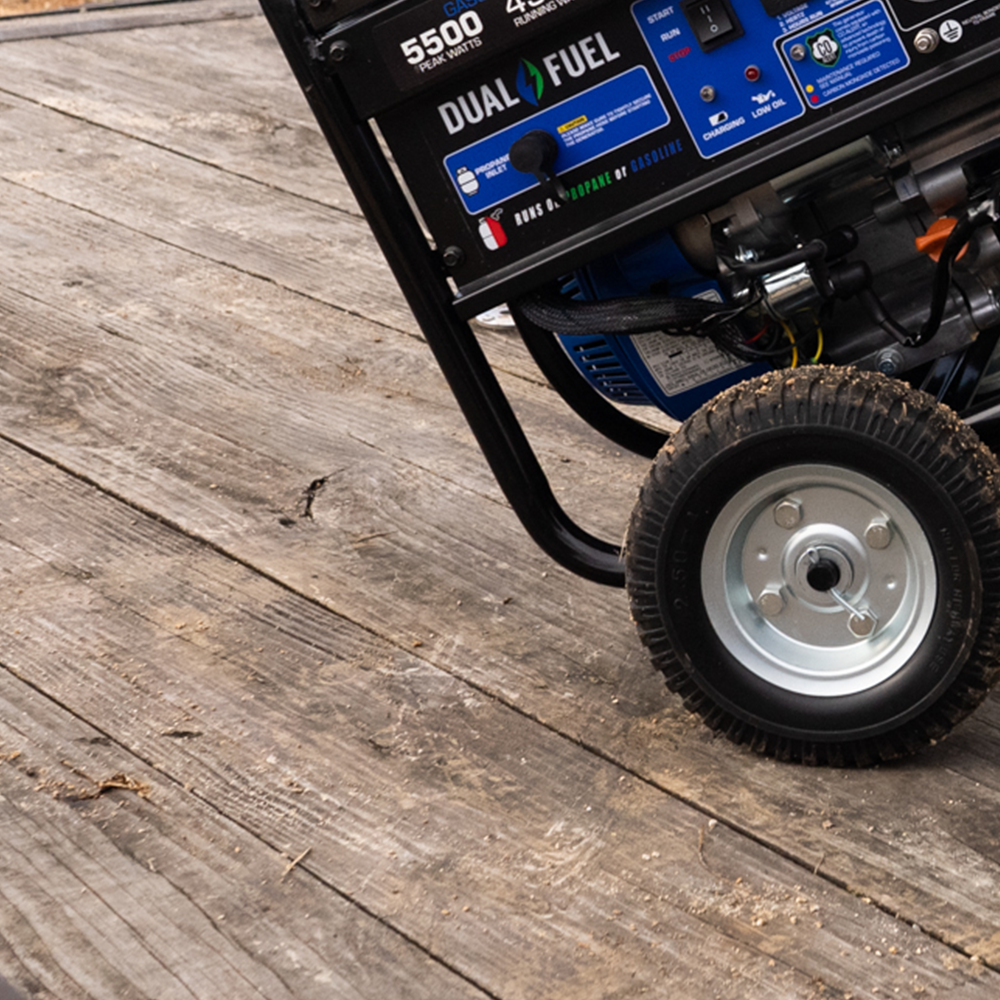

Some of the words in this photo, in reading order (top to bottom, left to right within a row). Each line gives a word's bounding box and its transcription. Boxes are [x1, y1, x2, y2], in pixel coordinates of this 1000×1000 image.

[513, 0, 557, 27] RUNNING
[647, 6, 674, 24] START
[400, 10, 483, 65] 5500
[660, 27, 681, 42] RUN
[418, 53, 447, 72] PEAK
[445, 36, 482, 59] WATTS
[667, 45, 692, 62] STOP
[816, 39, 833, 56] CO
[438, 78, 520, 135] DUAL
[543, 32, 621, 87] FUEL
[822, 83, 845, 97] CARBON
[845, 70, 872, 86] MONOXIDE
[872, 56, 900, 73] DETECTED
[751, 104, 772, 119] LOW
[771, 98, 787, 109] OIL
[702, 116, 746, 141] CHARGING
[484, 163, 507, 179] INLET
[514, 203, 543, 226] RUNS
[614, 166, 627, 180] or
[630, 138, 683, 172] GASOLINE
